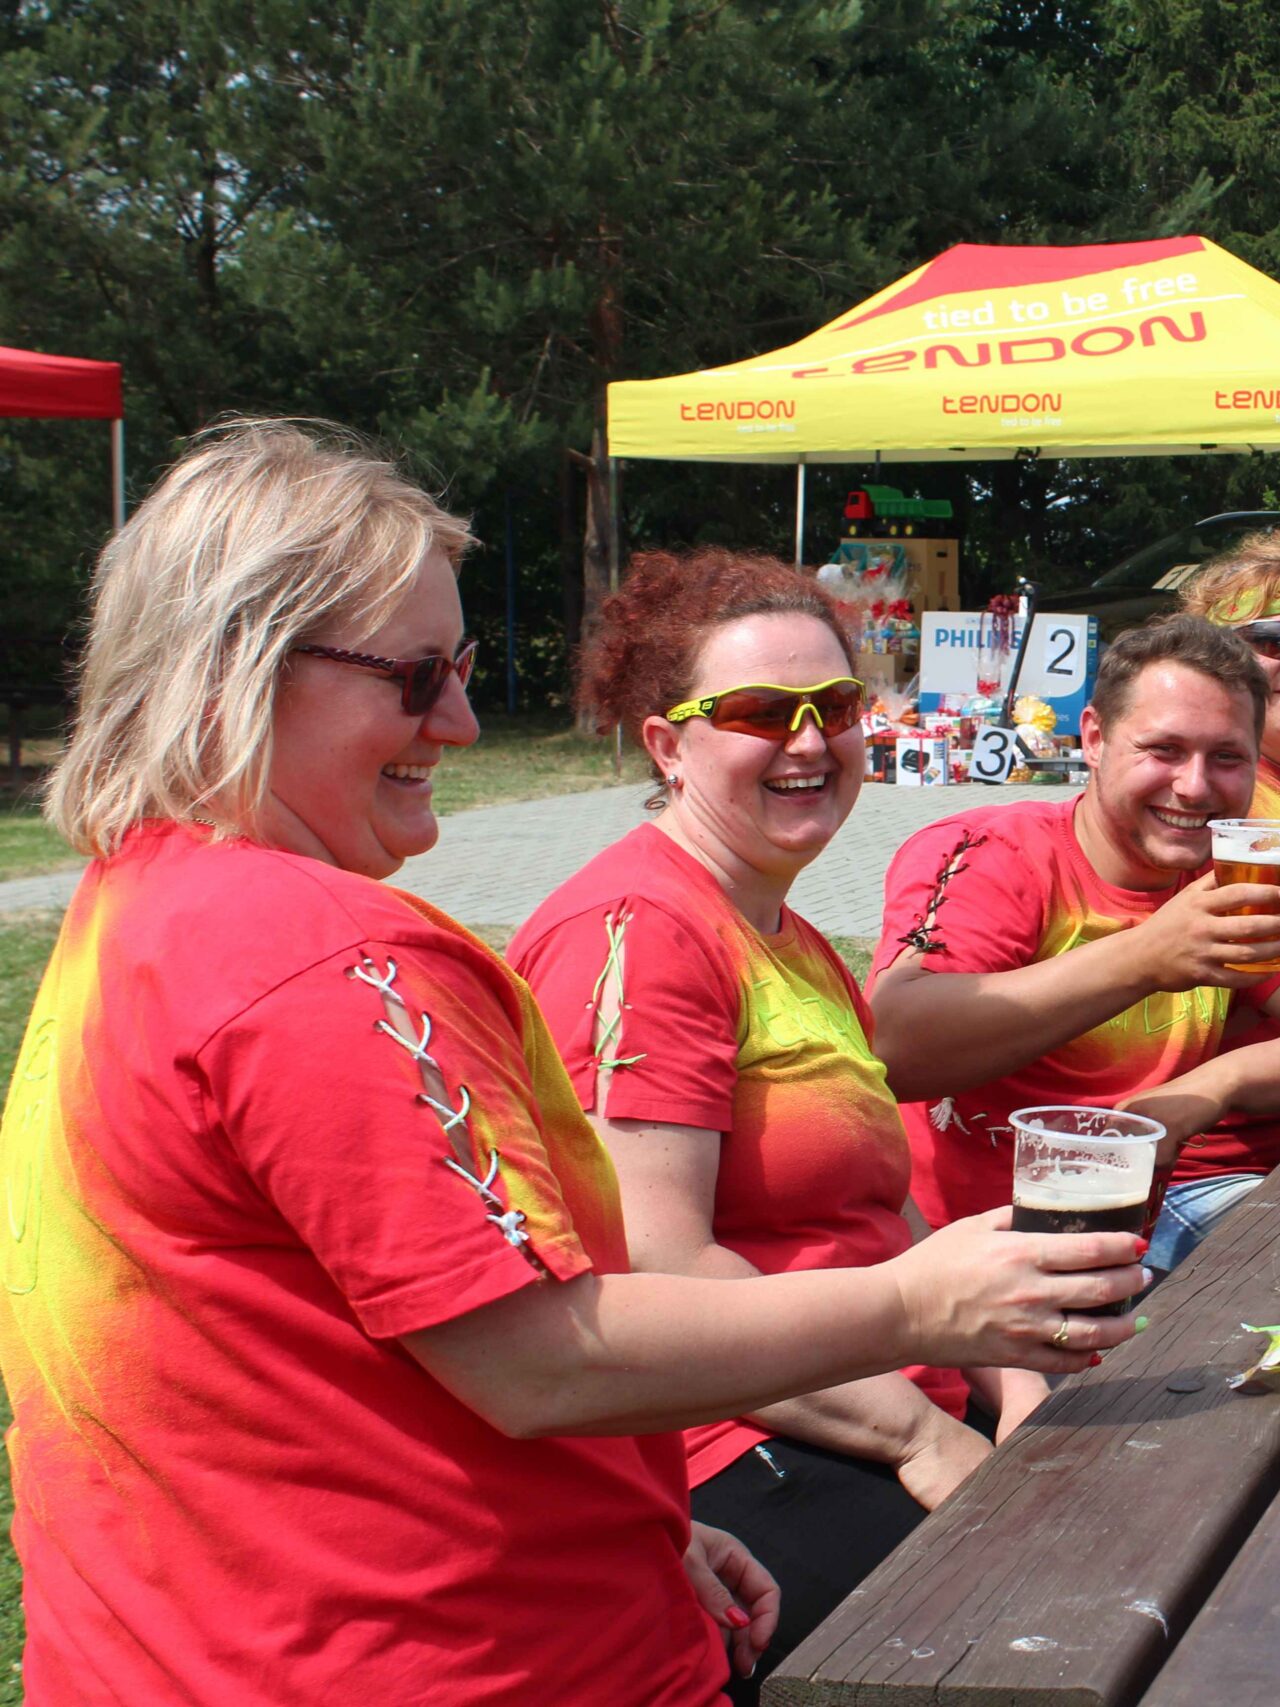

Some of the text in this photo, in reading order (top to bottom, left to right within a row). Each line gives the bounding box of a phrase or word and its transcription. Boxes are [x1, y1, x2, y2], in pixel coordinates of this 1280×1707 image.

[923, 274, 1197, 330] tied to be free
[935, 628, 1024, 650] PHILIS
[1046, 629, 1075, 675] 2
[976, 731, 1009, 776] 3
